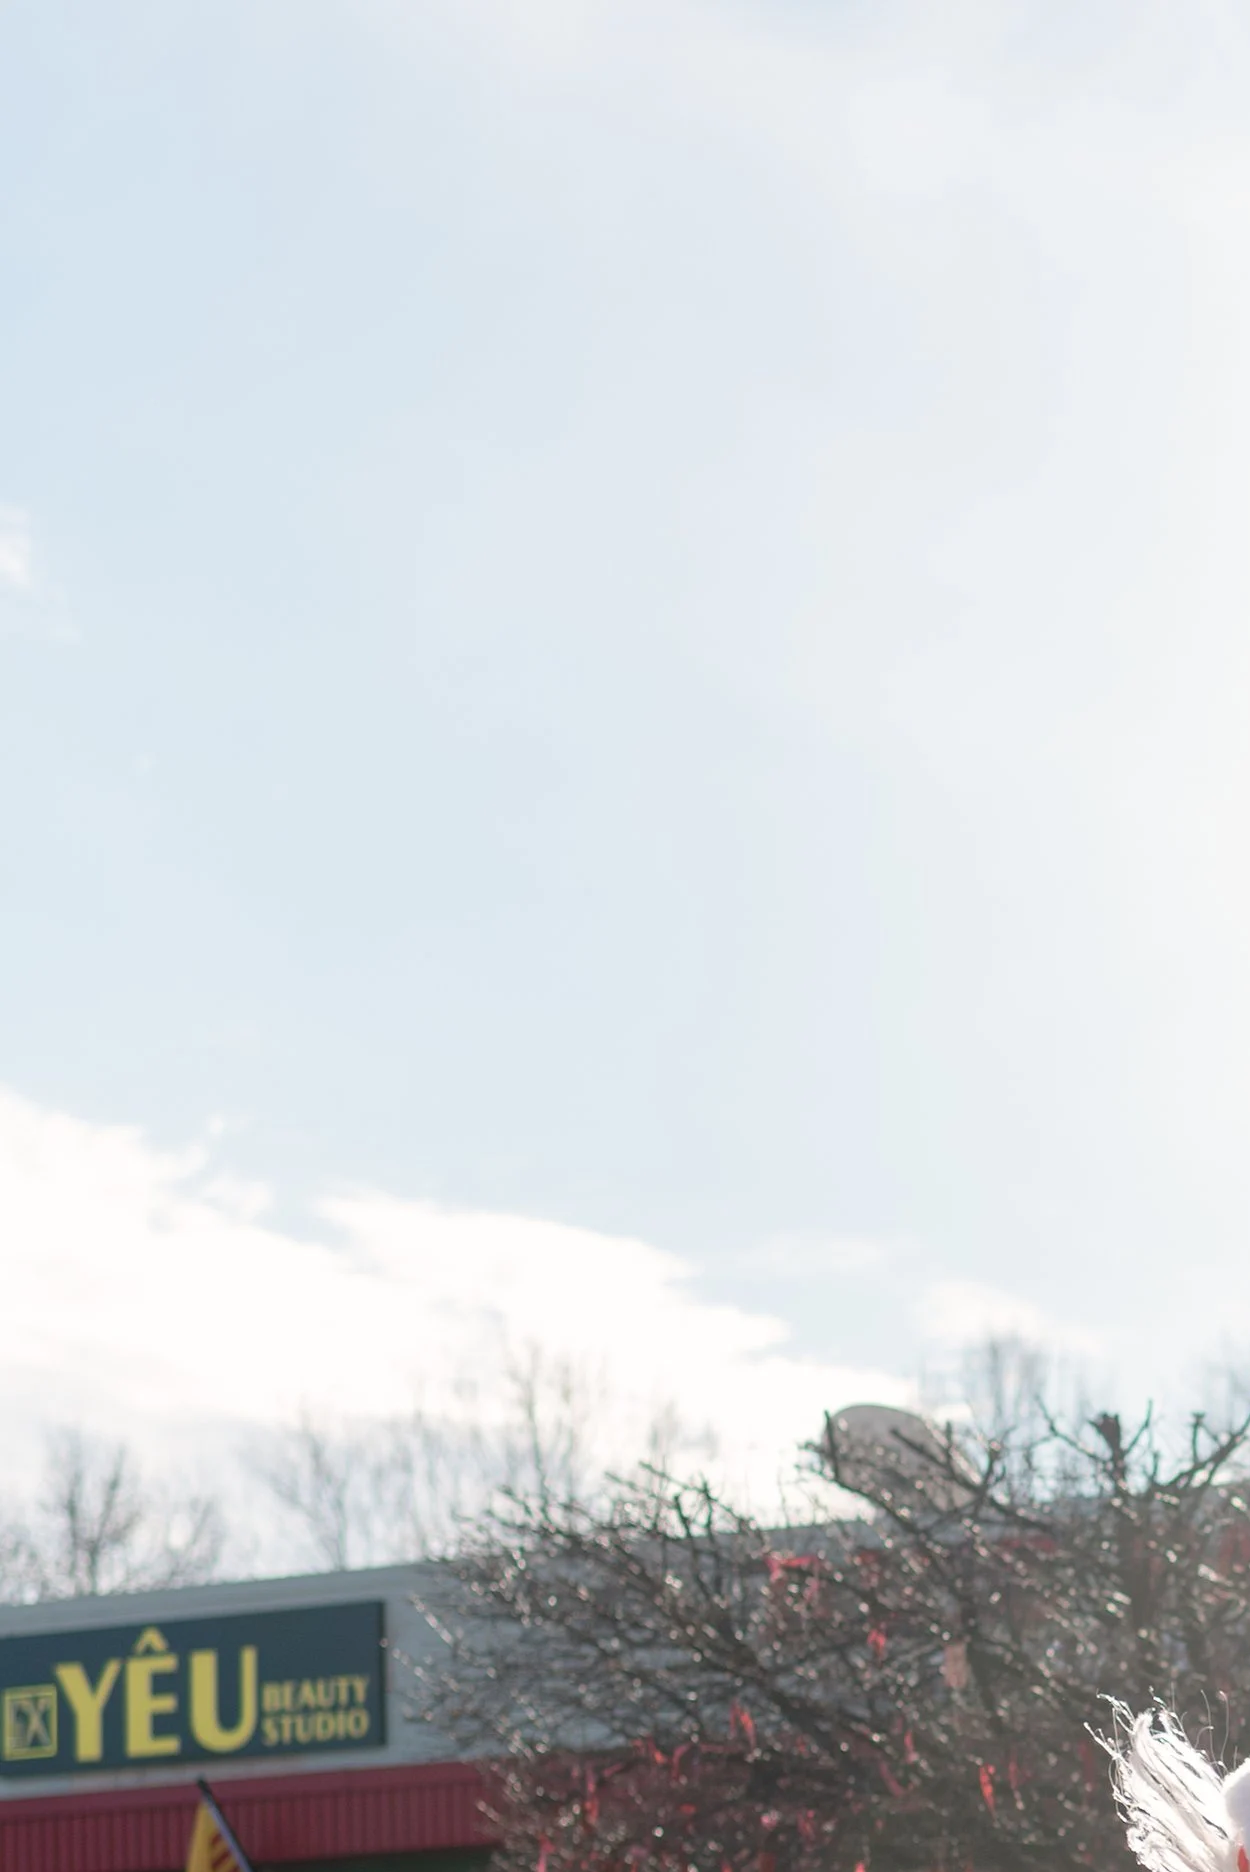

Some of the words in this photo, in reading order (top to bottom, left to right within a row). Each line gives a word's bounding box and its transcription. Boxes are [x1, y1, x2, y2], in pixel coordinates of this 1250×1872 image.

[55, 1626, 259, 1763] YÊU
[262, 1676, 370, 1713] BEAUTY
[262, 1706, 371, 1746] STUDIO
